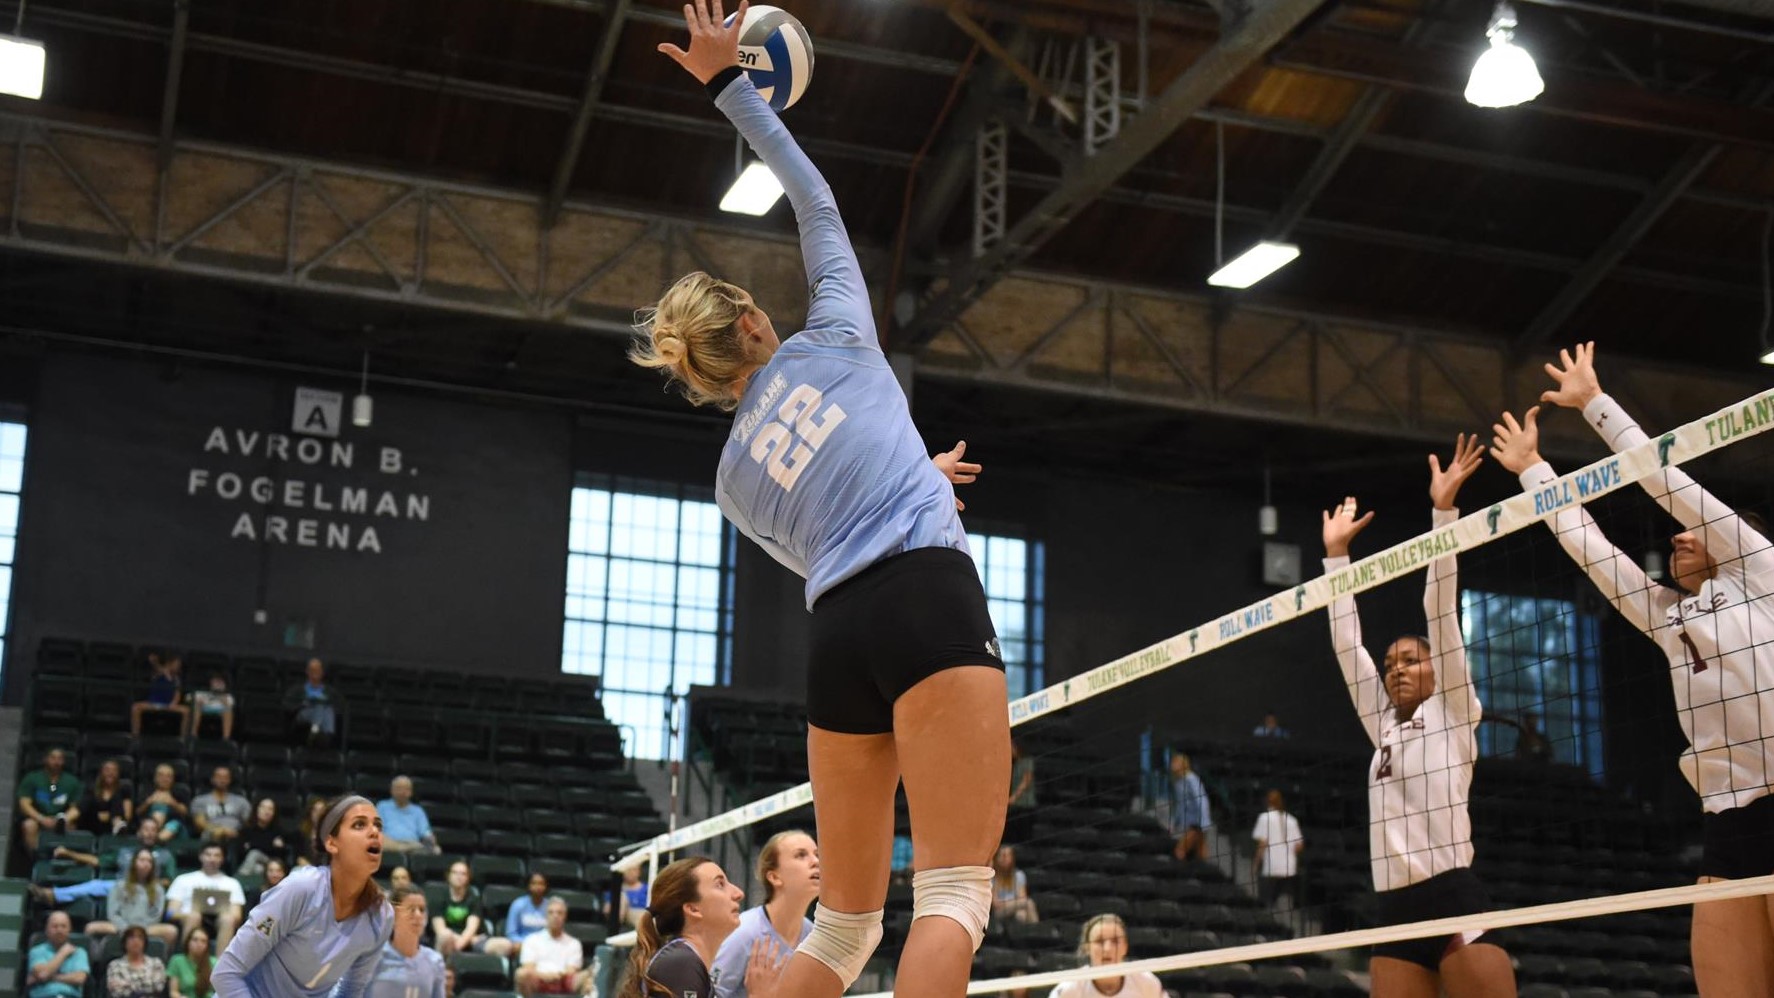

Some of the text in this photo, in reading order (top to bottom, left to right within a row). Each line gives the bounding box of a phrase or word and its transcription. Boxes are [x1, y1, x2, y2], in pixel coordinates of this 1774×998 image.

[304, 405, 328, 431] A
[751, 383, 847, 492] 22
[204, 426, 418, 476] AVRON B.
[188, 468, 430, 521] FOGELMAN
[1534, 460, 1621, 515] ROLL WAVE
[231, 512, 382, 553] ARENA
[1329, 528, 1459, 596] TULANE VOLLEYBALL
[1219, 602, 1273, 640] ROLL WAVE
[1678, 631, 1708, 675] 1
[1375, 744, 1393, 781] 2
